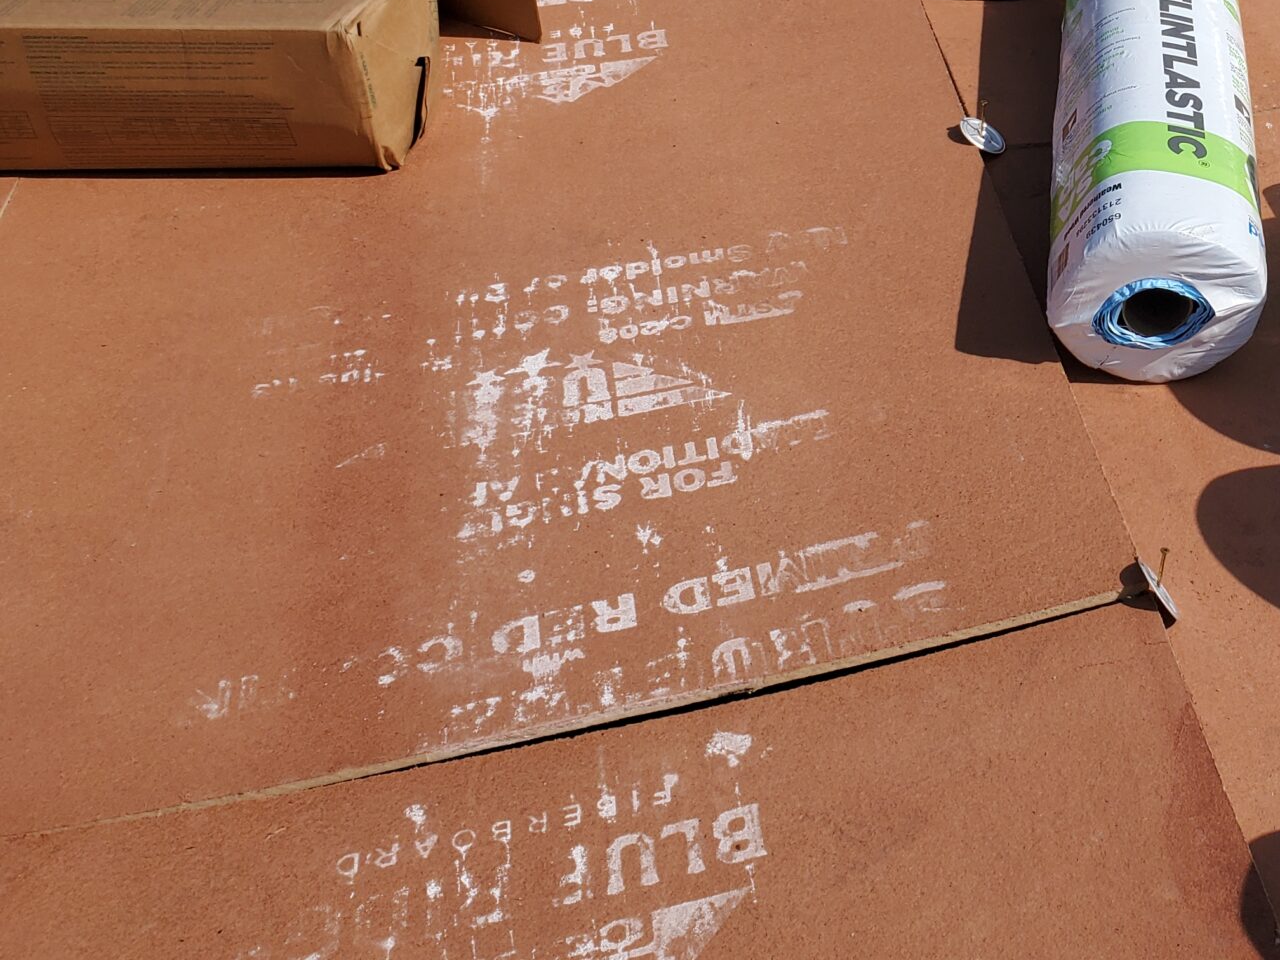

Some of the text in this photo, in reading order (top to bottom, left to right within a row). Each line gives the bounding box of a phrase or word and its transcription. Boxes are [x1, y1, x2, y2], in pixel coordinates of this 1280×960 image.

[541, 29, 669, 63] BLUE
[1080, 182, 1122, 220] Weathered
[1086, 212, 1122, 240] 650439
[639, 461, 739, 501] FOR
